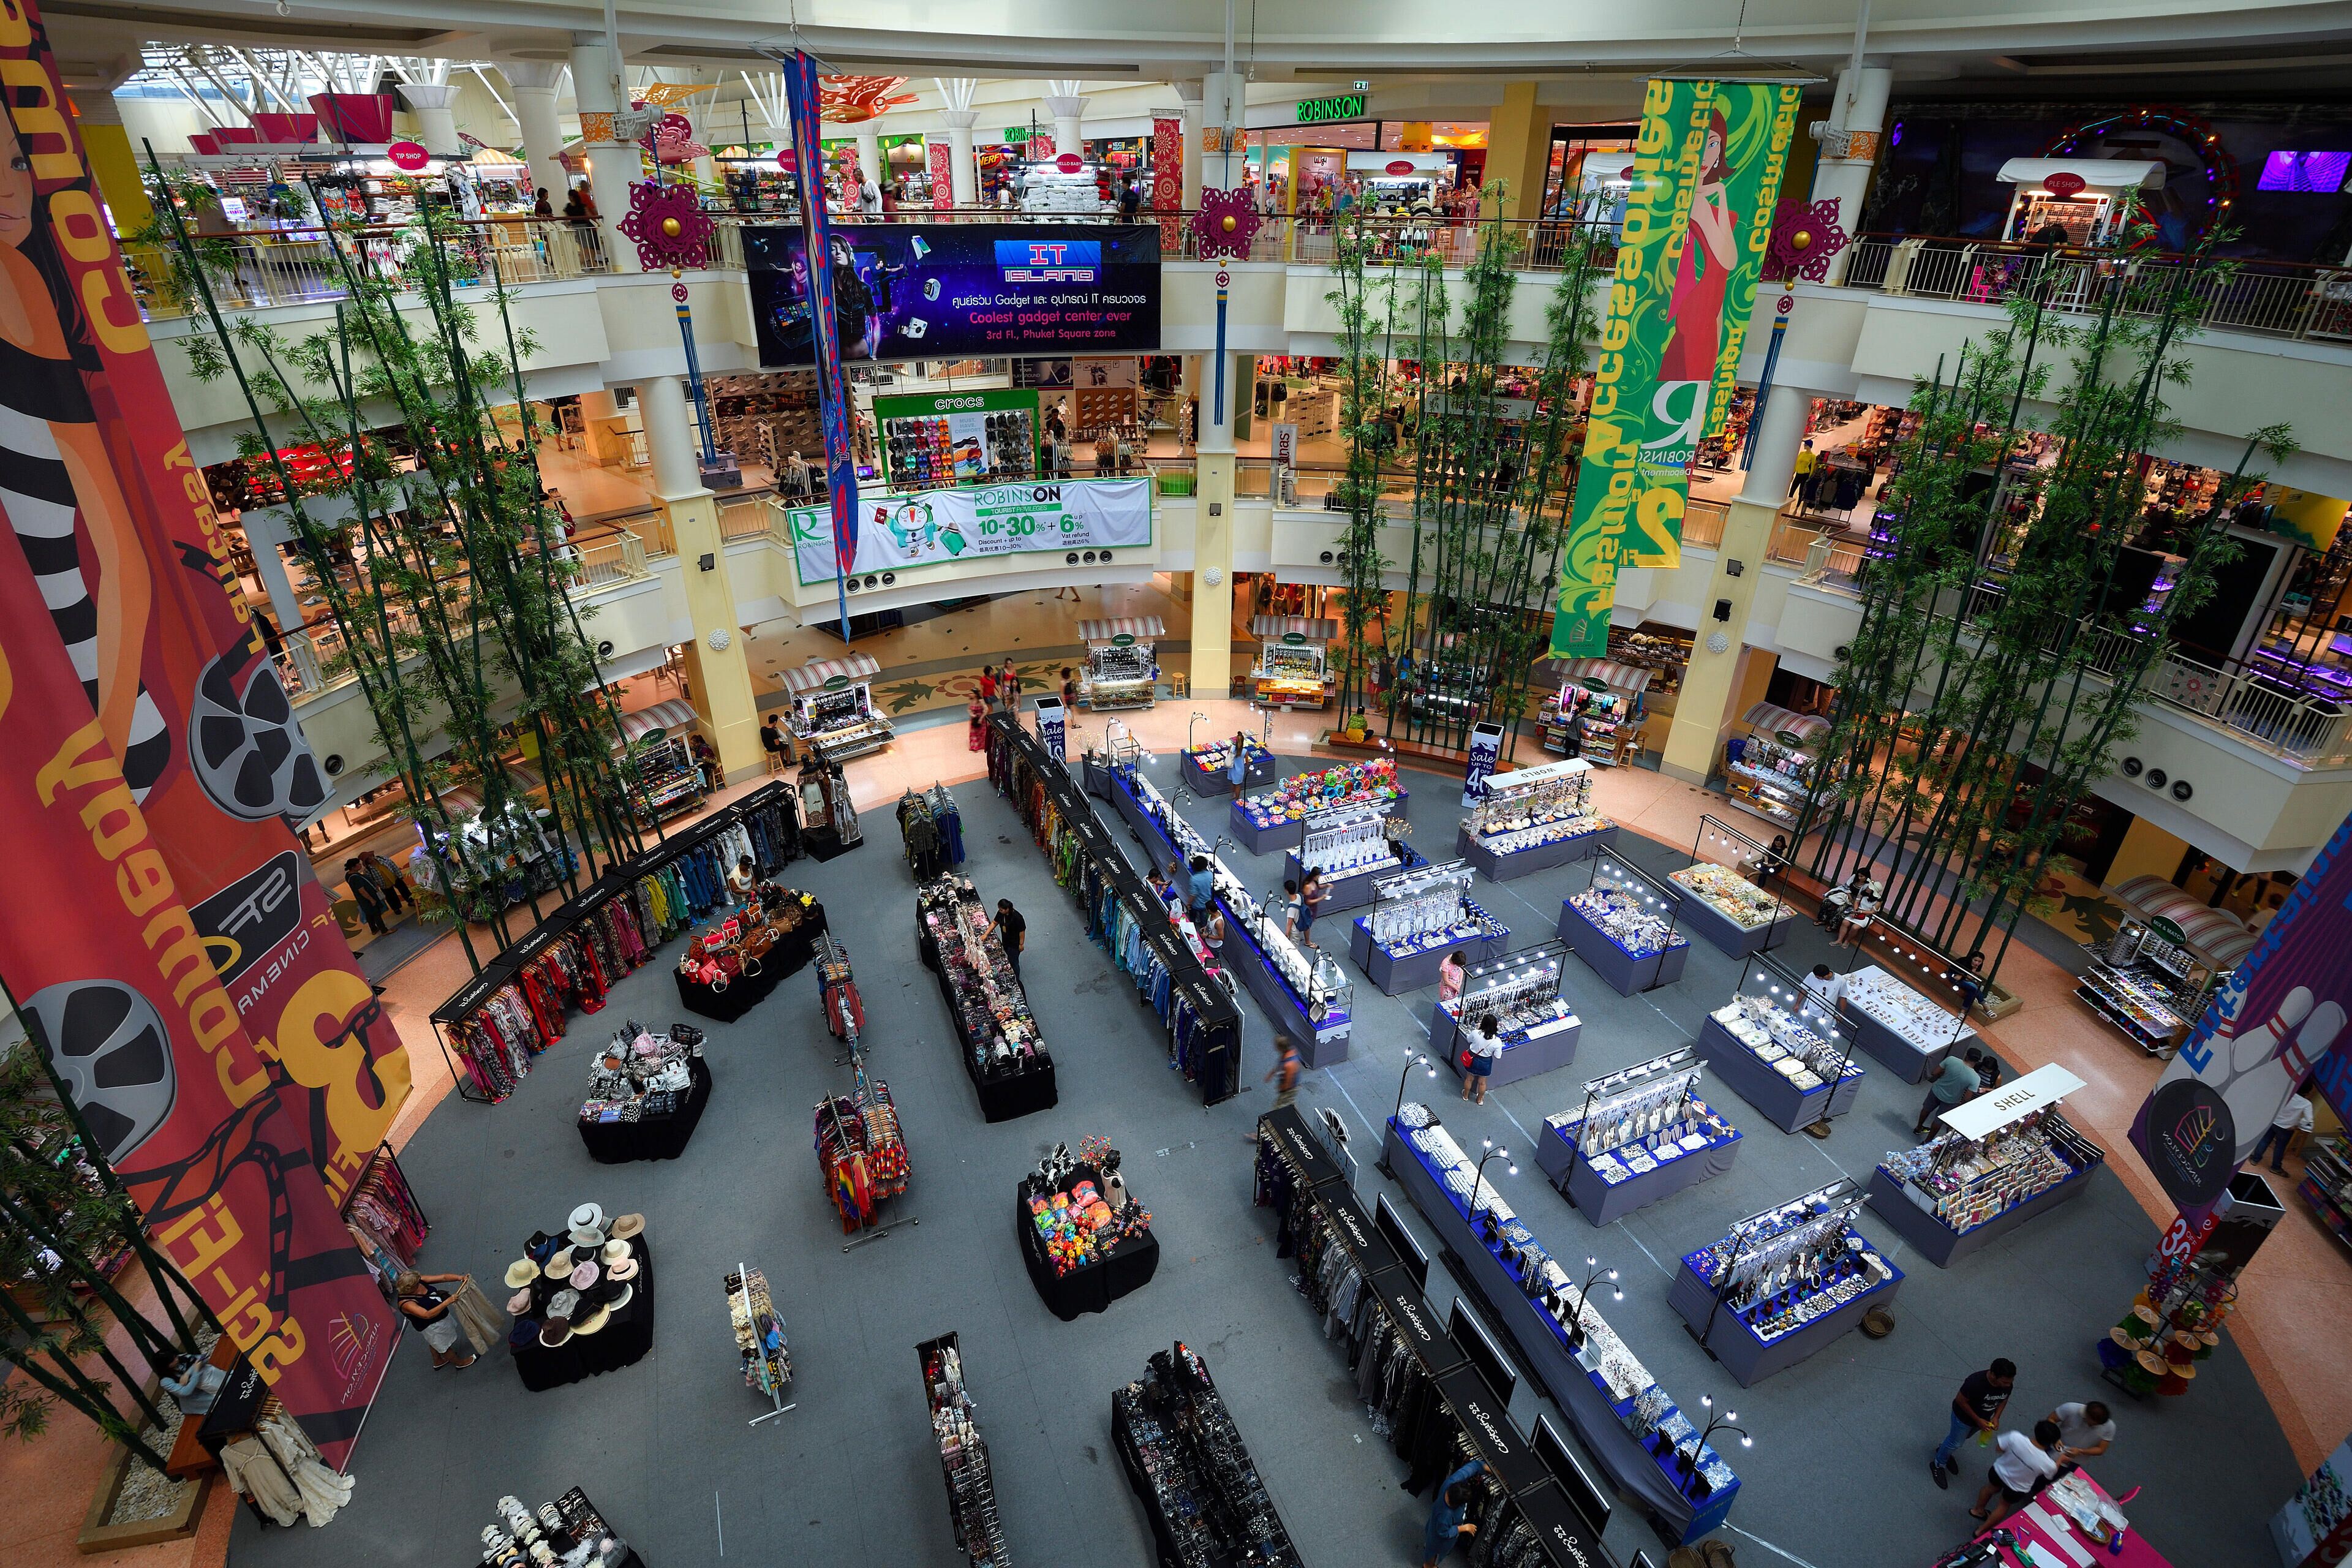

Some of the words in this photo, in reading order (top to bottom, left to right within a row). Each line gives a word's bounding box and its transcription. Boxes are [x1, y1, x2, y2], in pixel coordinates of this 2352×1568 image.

[1297, 96, 1363, 121] ROBINSON
[1004, 127, 1045, 141] ROBIN
[1029, 244, 1067, 265] IT
[1005, 270, 1094, 282] ISLAND
[995, 293, 1030, 307] Gadget
[1034, 295, 1047, 304] และ
[1050, 293, 1088, 307] อุปกรณ์
[1092, 293, 1099, 303] IT
[1102, 295, 1146, 304] ครบวงจร
[970, 311, 1012, 324] Coolest
[1018, 310, 1060, 325] gadget
[1065, 311, 1102, 322] center
[1106, 312, 1132, 322] ever
[986, 331, 1002, 340] 3rd
[1023, 329, 1055, 339] Phuket
[1058, 329, 1091, 341] Square
[1095, 329, 1115, 337] zone
[935, 396, 984, 410] crocs
[974, 486, 1061, 506] ROBINSON
[797, 512, 828, 541] R
[798, 540, 832, 549] ROBINSON
[1471, 752, 1496, 763] Sale
[1521, 767, 1557, 778] WORLD
[2167, 929, 2184, 941] MATCH
[1994, 1090, 2035, 1110] SHELL
[1292, 1133, 1313, 1159] Century
[1338, 1208, 1347, 1216] 22
[1344, 1216, 1367, 1246] Century
[2185, 1231, 2198, 1245] OFF
[1397, 1295, 1407, 1306] 22
[1403, 1305, 1430, 1340] Century
[1469, 1402, 1480, 1414] 22
[1476, 1413, 1509, 1453] Century
[1554, 1525, 1565, 1538] 22
